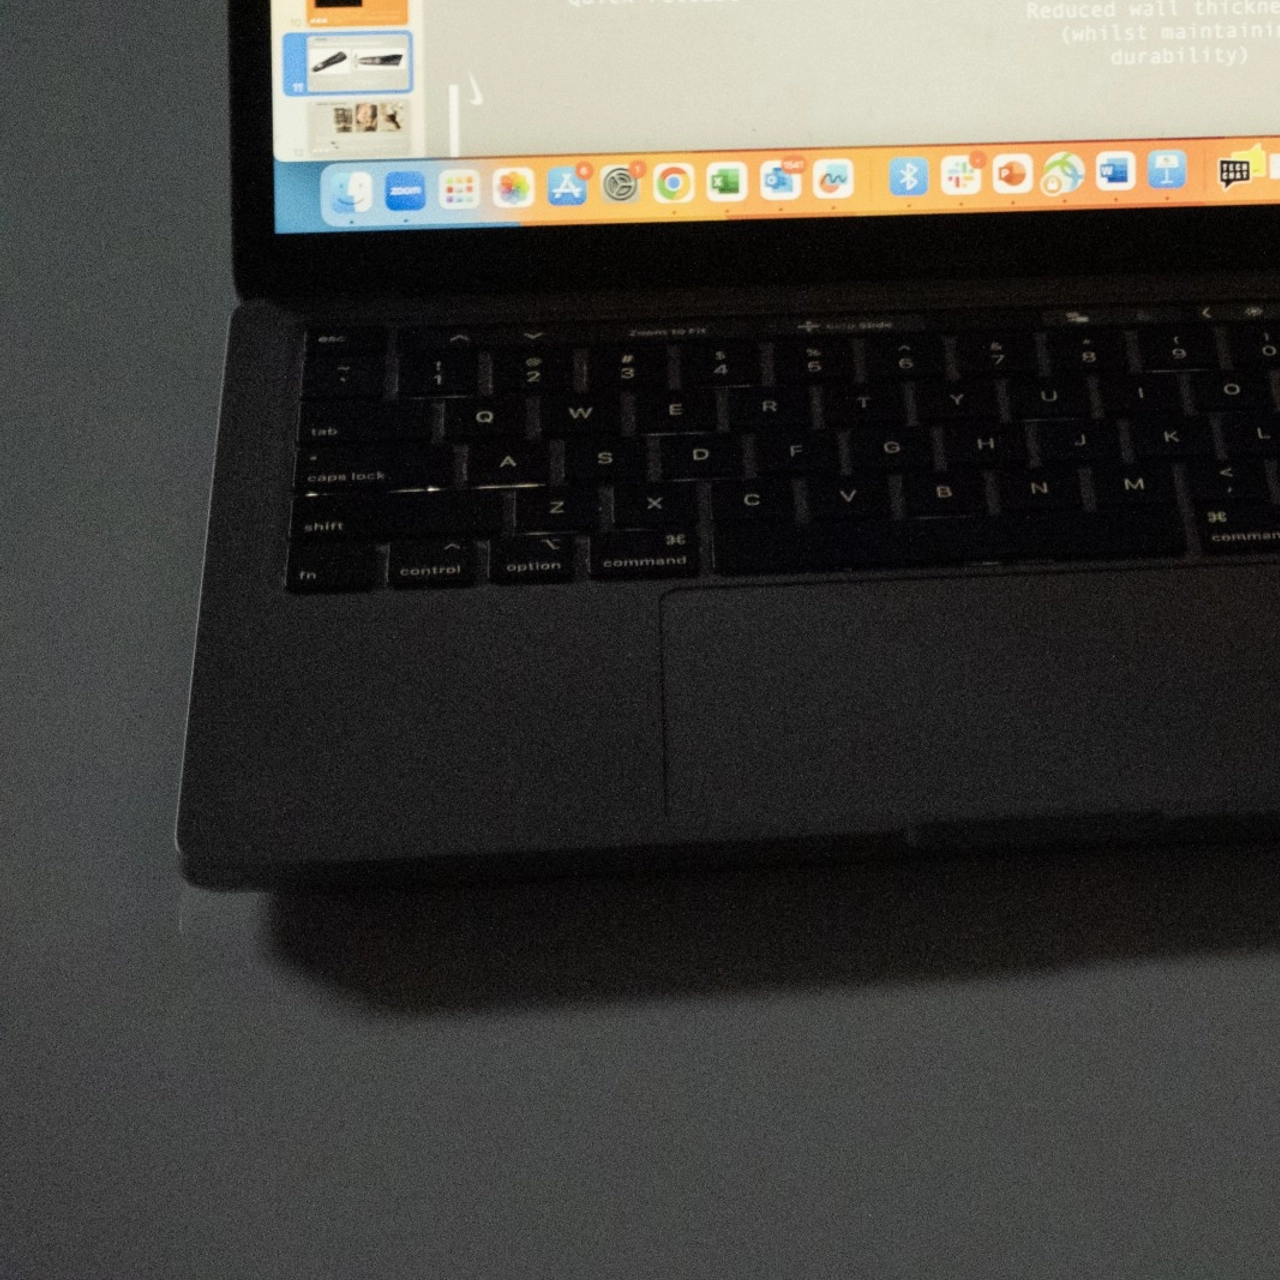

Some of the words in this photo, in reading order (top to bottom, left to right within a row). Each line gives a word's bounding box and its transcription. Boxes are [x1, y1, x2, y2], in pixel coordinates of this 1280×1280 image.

[1027, 0, 1116, 20] Reduced
[1129, 0, 1178, 17] wall
[1062, 24, 1147, 45] (whilst
[1111, 46, 1249, 68] durability)
[1222, 162, 1248, 172] TECH
[1222, 171, 1249, 181] CHAT
[390, 186, 420, 196] zoom
[990, 353, 1006, 366] 7
[1172, 348, 1187, 360] 9
[714, 363, 729, 376] 4
[898, 358, 914, 370] 6
[433, 373, 442, 386] 1
[527, 370, 542, 382] 2
[620, 367, 636, 380] 3
[1138, 386, 1144, 399] I
[1224, 383, 1241, 396] O
[858, 396, 871, 408] T
[950, 394, 965, 406] Y
[1042, 390, 1058, 403] U
[668, 403, 684, 416] E
[762, 400, 778, 412] R
[476, 410, 495, 424] Q
[568, 406, 594, 420] W
[311, 426, 338, 436] tab
[1163, 430, 1180, 442] K
[1256, 427, 1271, 440] L
[977, 438, 994, 450] H
[1074, 434, 1088, 446] J
[790, 444, 804, 458] F
[884, 440, 902, 454] G
[597, 452, 614, 465] S
[692, 447, 710, 461] D
[500, 456, 517, 468] A
[307, 472, 347, 484] caps
[350, 470, 386, 481] lock
[1030, 482, 1049, 495] N
[1124, 478, 1144, 491] M
[839, 490, 858, 503] V
[936, 486, 954, 499] B
[646, 496, 663, 510] X
[742, 493, 761, 507] C
[550, 500, 565, 514] Z
[304, 520, 344, 532] shift
[506, 559, 562, 573] option
[602, 554, 687, 568] command
[299, 569, 316, 581] fn
[400, 563, 461, 576] control
